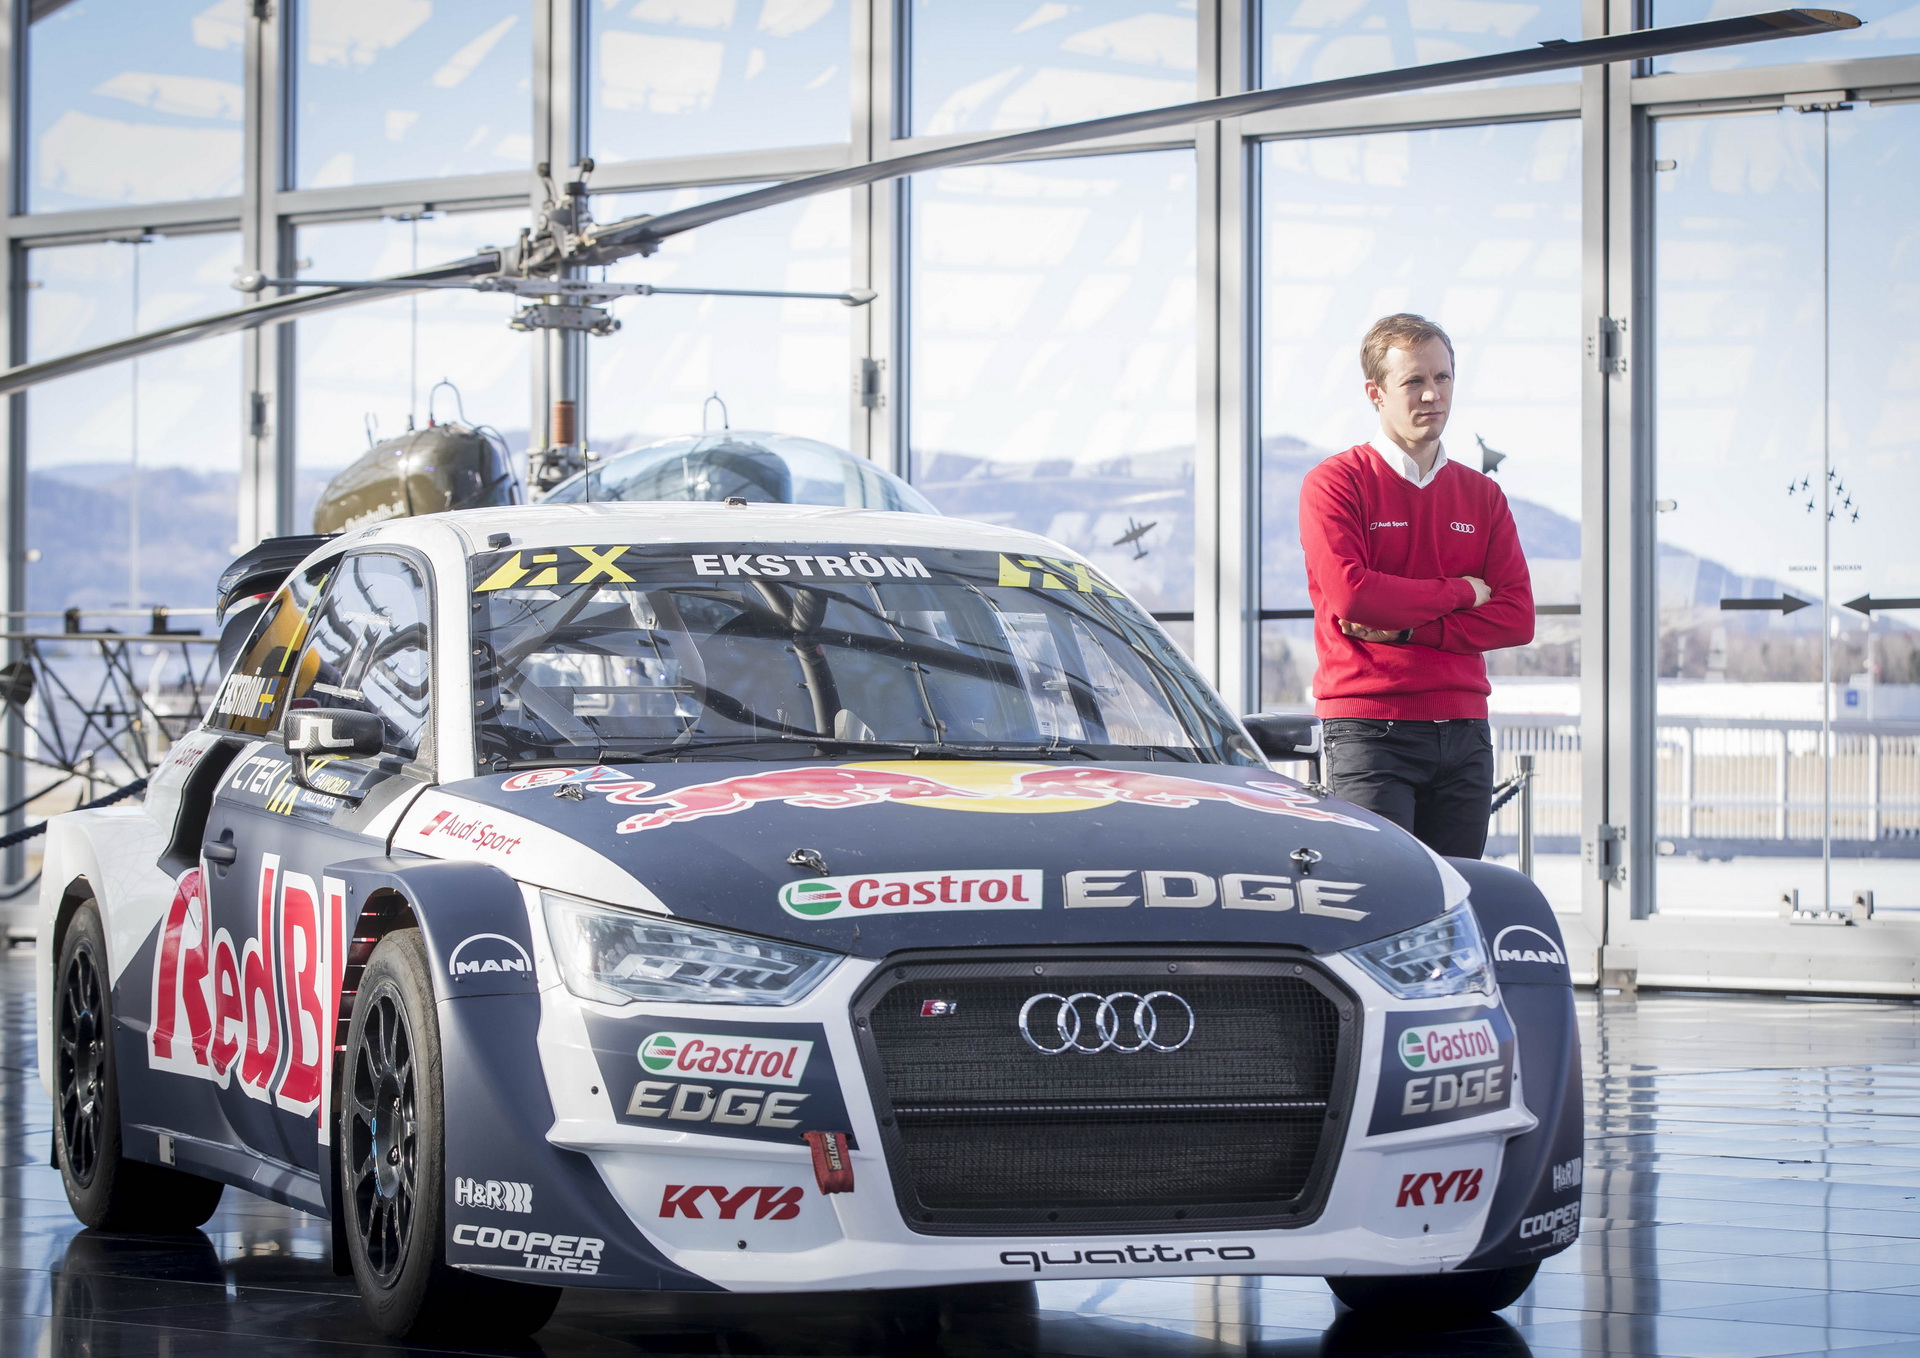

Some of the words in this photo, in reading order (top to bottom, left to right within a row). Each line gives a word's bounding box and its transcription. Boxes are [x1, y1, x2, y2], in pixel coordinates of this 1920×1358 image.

[691, 551, 932, 578] EKSTRÖM
[218, 667, 266, 718] EKSTRÖM
[231, 755, 291, 796] CTEK
[439, 814, 482, 840] Audi
[472, 824, 522, 854] Sport
[848, 873, 1029, 909] Castrol
[1064, 870, 1371, 921] EDGE
[456, 958, 525, 975] MAN
[1500, 949, 1560, 964] MAN
[931, 1001, 957, 1014] S1
[677, 1039, 798, 1079] Castrol
[1426, 1025, 1495, 1064] Castrol
[626, 1081, 812, 1129] EDGE
[1401, 1065, 1505, 1116] EDGE
[455, 1176, 506, 1211] H&R
[659, 1185, 804, 1220] KYB
[1396, 1168, 1483, 1207] KYB
[1519, 1200, 1580, 1239] COOPER
[1552, 1222, 1578, 1244] TIRES
[453, 1223, 605, 1260] COOPER
[1000, 1244, 1256, 1272] quattro
[523, 1253, 600, 1275] TIRES
